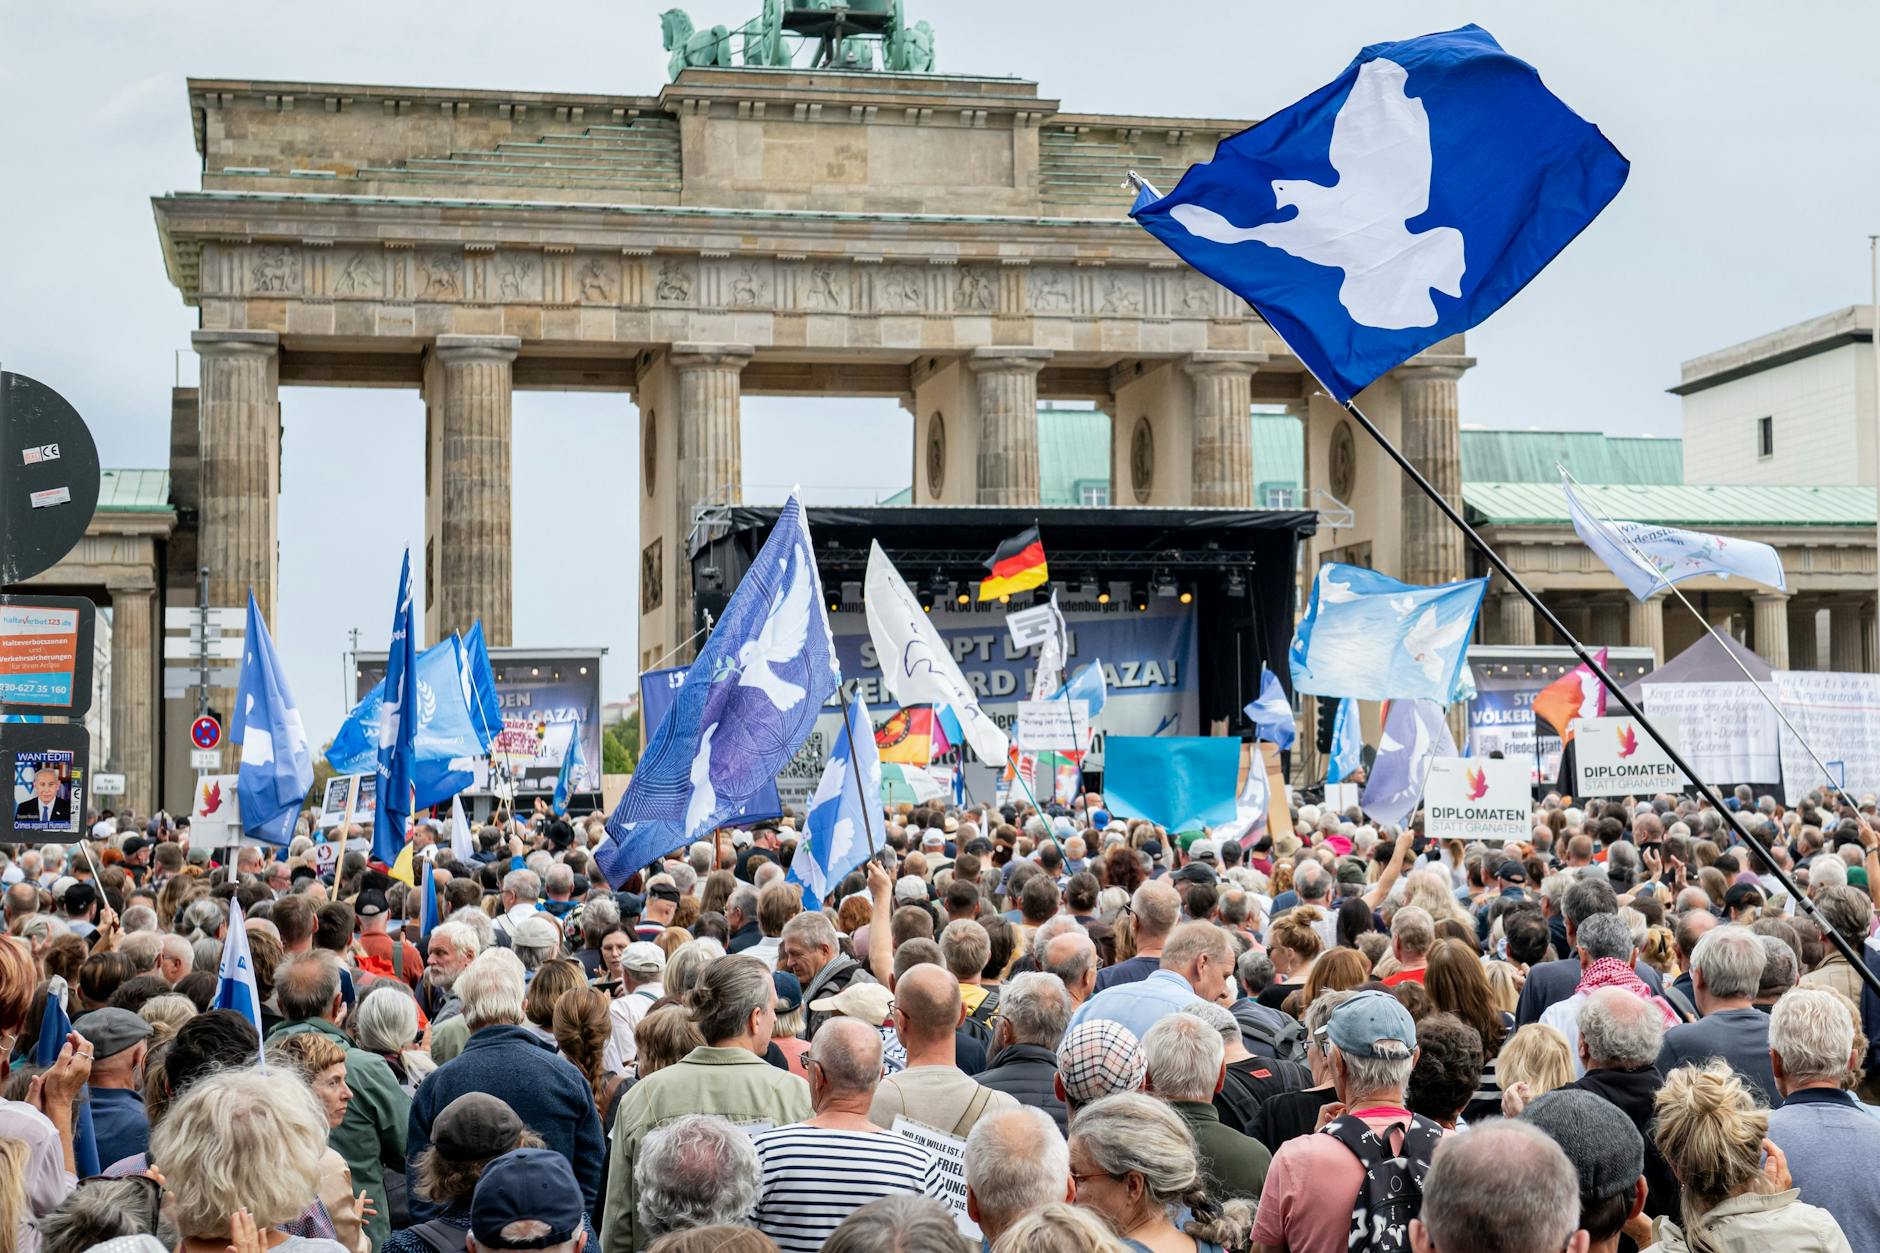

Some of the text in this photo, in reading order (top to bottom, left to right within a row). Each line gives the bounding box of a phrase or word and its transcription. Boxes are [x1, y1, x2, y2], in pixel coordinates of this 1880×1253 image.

[37, 685, 48, 693] 35
[51, 686, 67, 694] 160
[18, 753, 70, 761] WANTED!!!
[1583, 763, 1676, 778] DIPLOMATEN
[1584, 776, 1677, 791] STATT GRANATEN!
[1432, 807, 1525, 821] DIPLOMATEN
[1431, 821, 1526, 834] STATT GRANATEN!
[926, 1139, 948, 1153] WILLE
